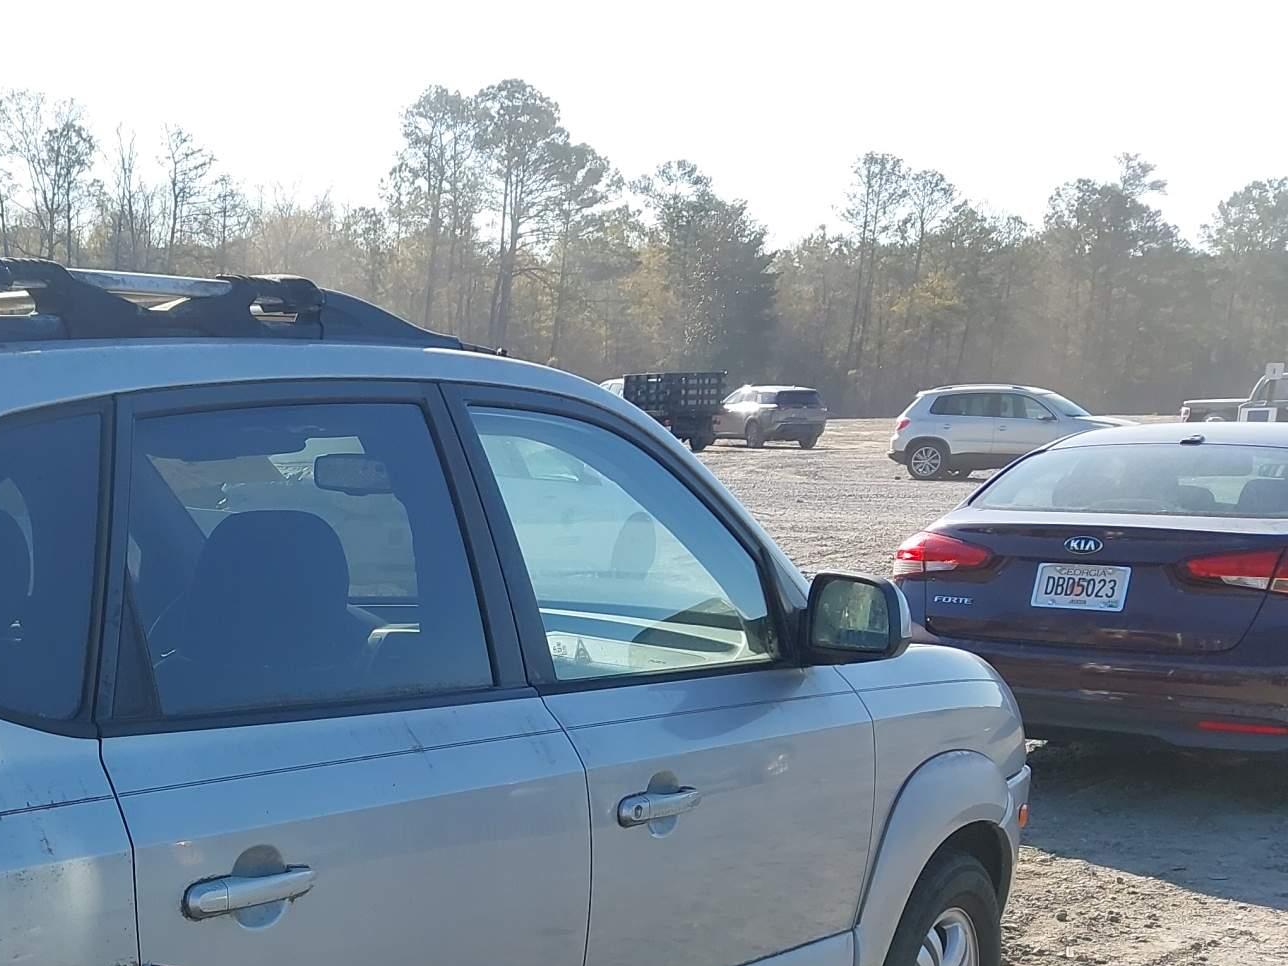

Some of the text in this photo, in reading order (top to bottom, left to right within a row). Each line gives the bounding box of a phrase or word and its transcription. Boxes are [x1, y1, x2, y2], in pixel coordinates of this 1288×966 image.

[1069, 541, 1096, 551] KIA
[1061, 568, 1107, 577] GEORGIA
[1044, 576, 1117, 598] DBD5023
[934, 595, 974, 605] FORTE
